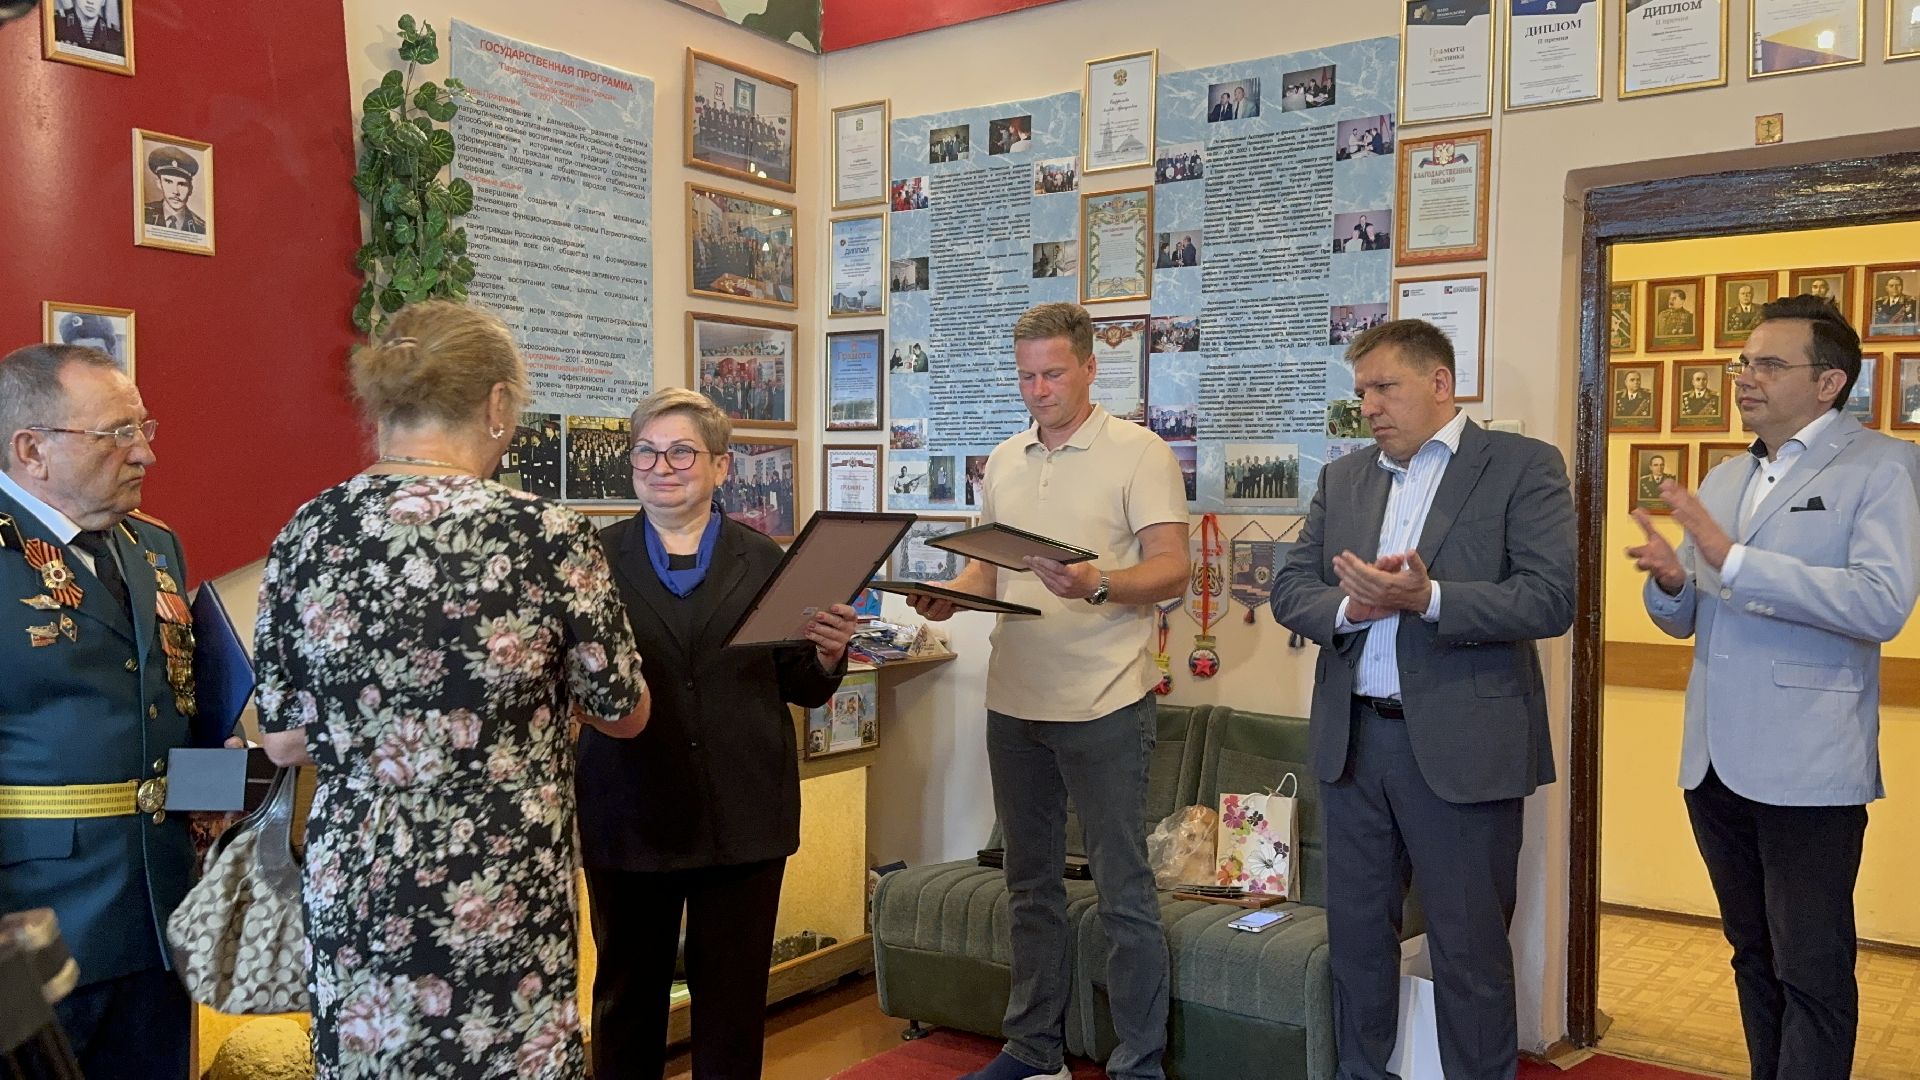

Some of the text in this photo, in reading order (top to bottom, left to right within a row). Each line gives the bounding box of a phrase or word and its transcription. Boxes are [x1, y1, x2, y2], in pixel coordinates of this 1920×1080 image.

[1642, 0, 1703, 20] ДИПЛОМ
[1525, 19, 1582, 38] ДИПЛОМ
[1545, 35, 1569, 44] премия
[480, 39, 634, 93] ГОСУДАРСТВЕННАЯ ПРОГРАММА
[459, 105, 514, 125] патриотического
[516, 117, 552, 133] воспитания
[553, 129, 578, 141] граждан
[580, 134, 613, 148] Российской
[459, 115, 493, 130] способной
[505, 127, 527, 139] основе
[529, 134, 564, 147] воспитания
[566, 139, 585, 150] любви
[547, 118, 587, 132] дальнейшее
[591, 128, 619, 140] развитие
[624, 138, 649, 148] системы
[458, 134, 508, 151] сформировать
[514, 147, 518, 155] у
[523, 149, 550, 160] граждан
[612, 169, 638, 180] сознания
[472, 128, 521, 144] преумножения
[530, 142, 573, 157] исторических
[581, 153, 610, 165] традиций
[616, 161, 647, 174] Отечества
[458, 144, 504, 159] обеспечивать
[510, 155, 553, 170] поддержание
[558, 165, 602, 181] общественной
[458, 153, 494, 167] упрочение
[502, 162, 533, 175] единства
[551, 174, 576, 185] дружбы
[583, 181, 607, 191] народов
[613, 187, 646, 200] Российской
[1413, 167, 1472, 180] БЛАГОДАРСТВЕННОЕ
[477, 187, 519, 200] завершение
[528, 196, 557, 207] создания
[578, 207, 606, 217] развития
[466, 222, 485, 231] тания
[487, 225, 513, 235] граждан
[515, 230, 551, 243] Российской
[512, 213, 571, 231] функционирование
[574, 224, 599, 234] системы
[601, 228, 647, 244] Патриотического
[474, 234, 519, 247] мобилизация
[543, 245, 555, 253] сил
[559, 248, 588, 259] общества
[605, 257, 648, 269] формирование
[845, 246, 870, 256] ДИПЛОМ
[493, 255, 522, 266] сознания
[553, 265, 590, 277] обеспечение
[592, 272, 620, 282] активного
[621, 277, 642, 286] участия
[508, 277, 545, 287] воспитании
[604, 291, 639, 302] социальных
[530, 307, 545, 315] норм
[551, 311, 583, 321] поведения
[532, 326, 569, 336] реализации
[573, 331, 623, 344] конституционных
[565, 355, 579, 363] 2001
[600, 361, 613, 369] годы
[582, 350, 609, 359] воинского
[837, 352, 872, 361] Грамота
[536, 382, 561, 392] уровень
[566, 383, 604, 393] патриотизма
[621, 389, 639, 397] одной
[558, 374, 606, 384] эффективности
[614, 379, 649, 388] реализации
[551, 391, 581, 400] отдельной
